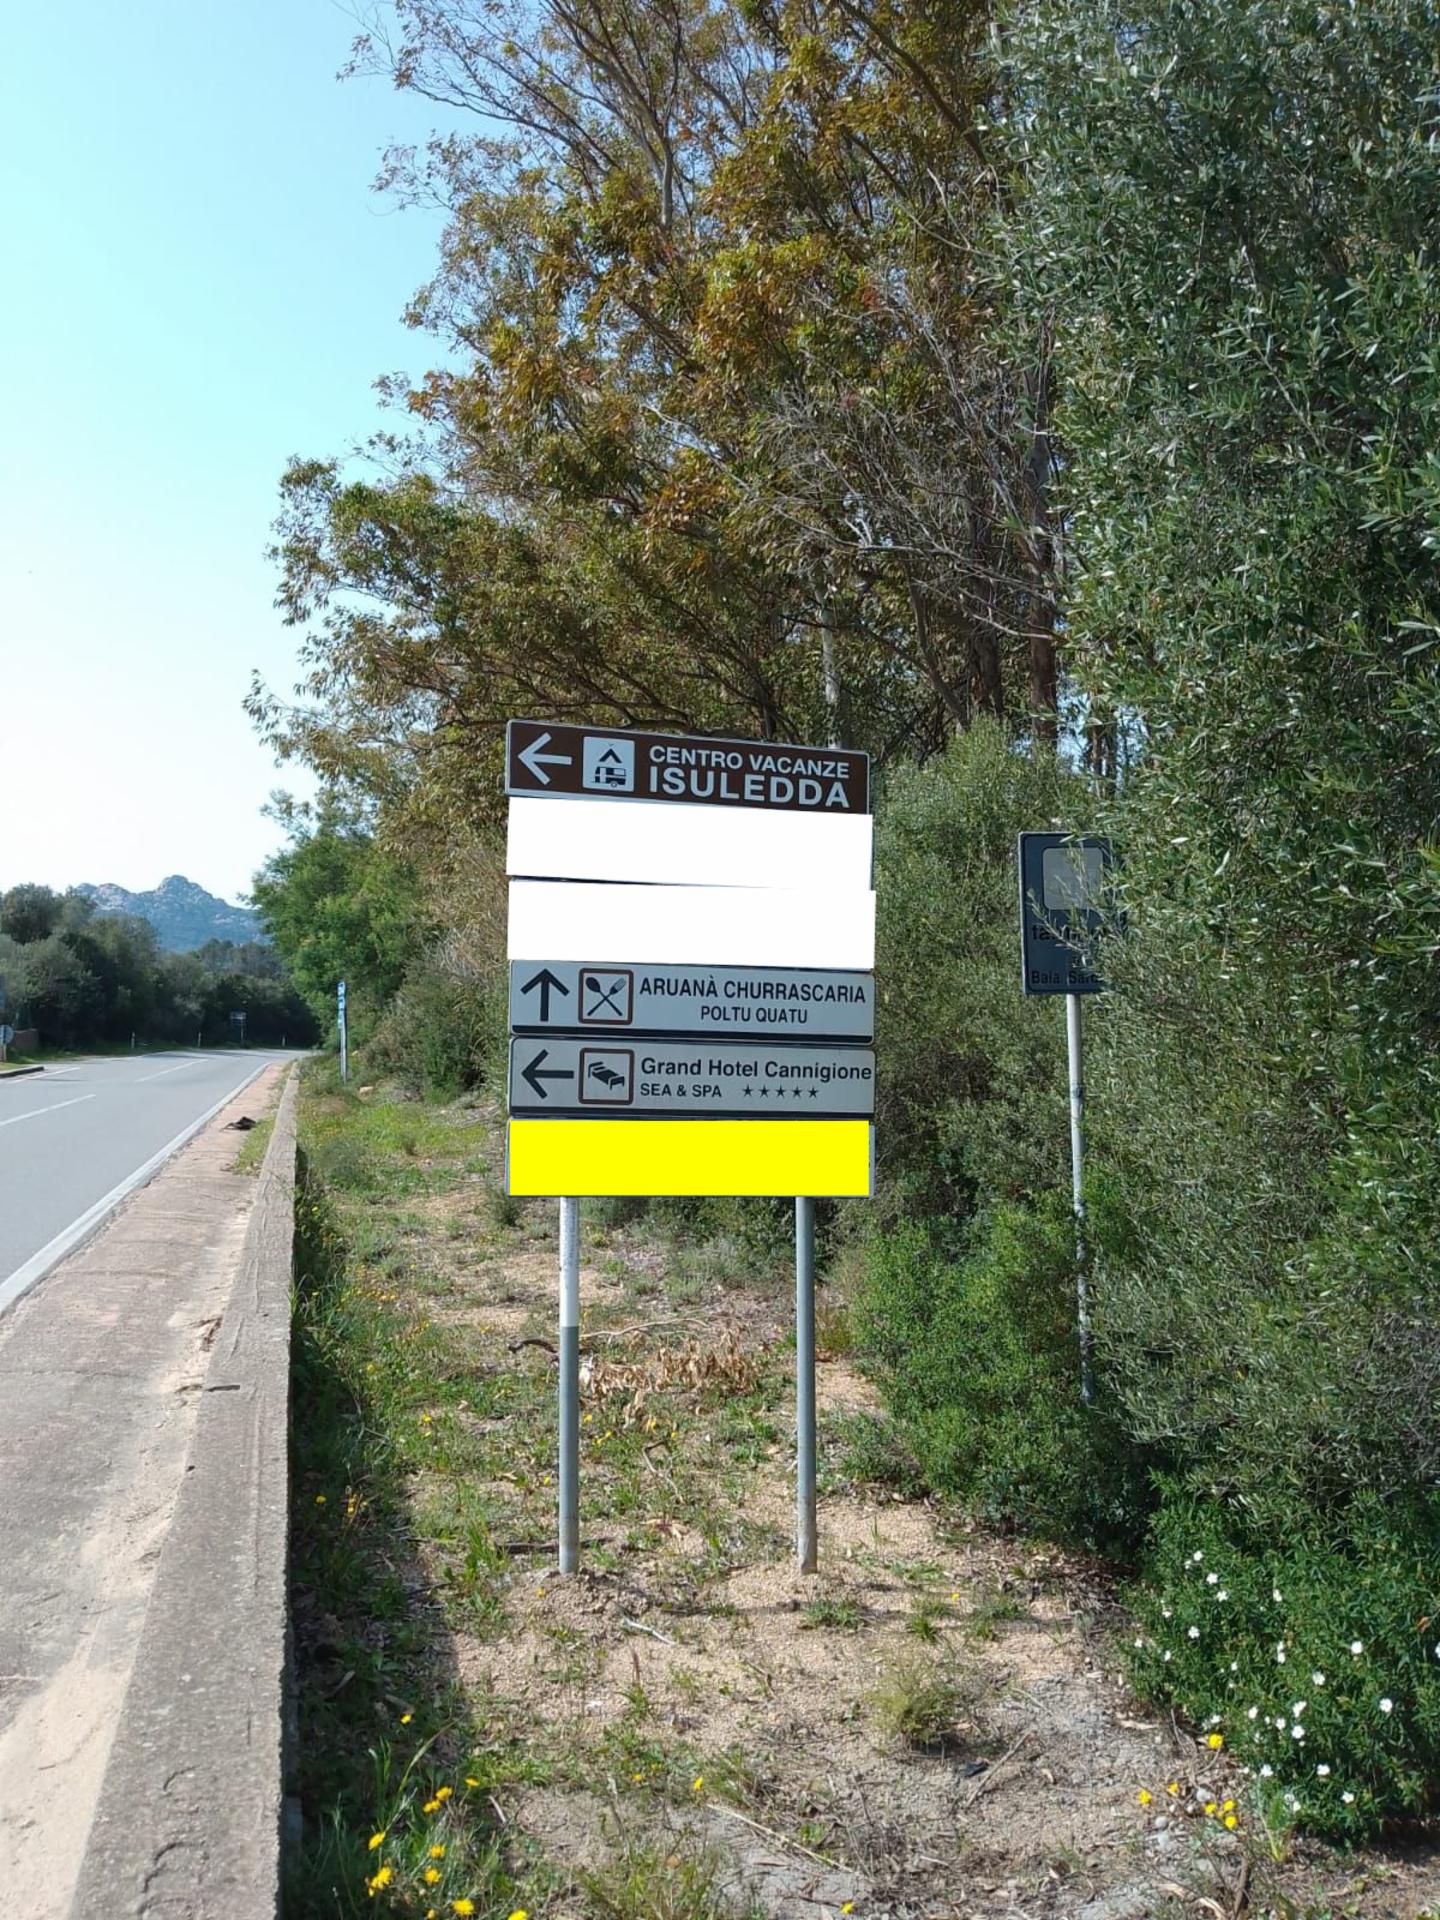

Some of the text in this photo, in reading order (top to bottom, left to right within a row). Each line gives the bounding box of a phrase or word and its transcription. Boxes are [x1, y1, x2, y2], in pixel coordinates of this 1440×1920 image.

[649, 745, 849, 779] CENTRO VACANZE
[649, 766, 850, 808] ISULEDDA
[639, 975, 866, 1003] ARUANÀ CHURRASCARIA
[701, 1005, 808, 1024] POLTU QUATU
[641, 1057, 872, 1083] Grand Hotel Cannigione
[640, 1083, 722, 1098] SEA & SPA
